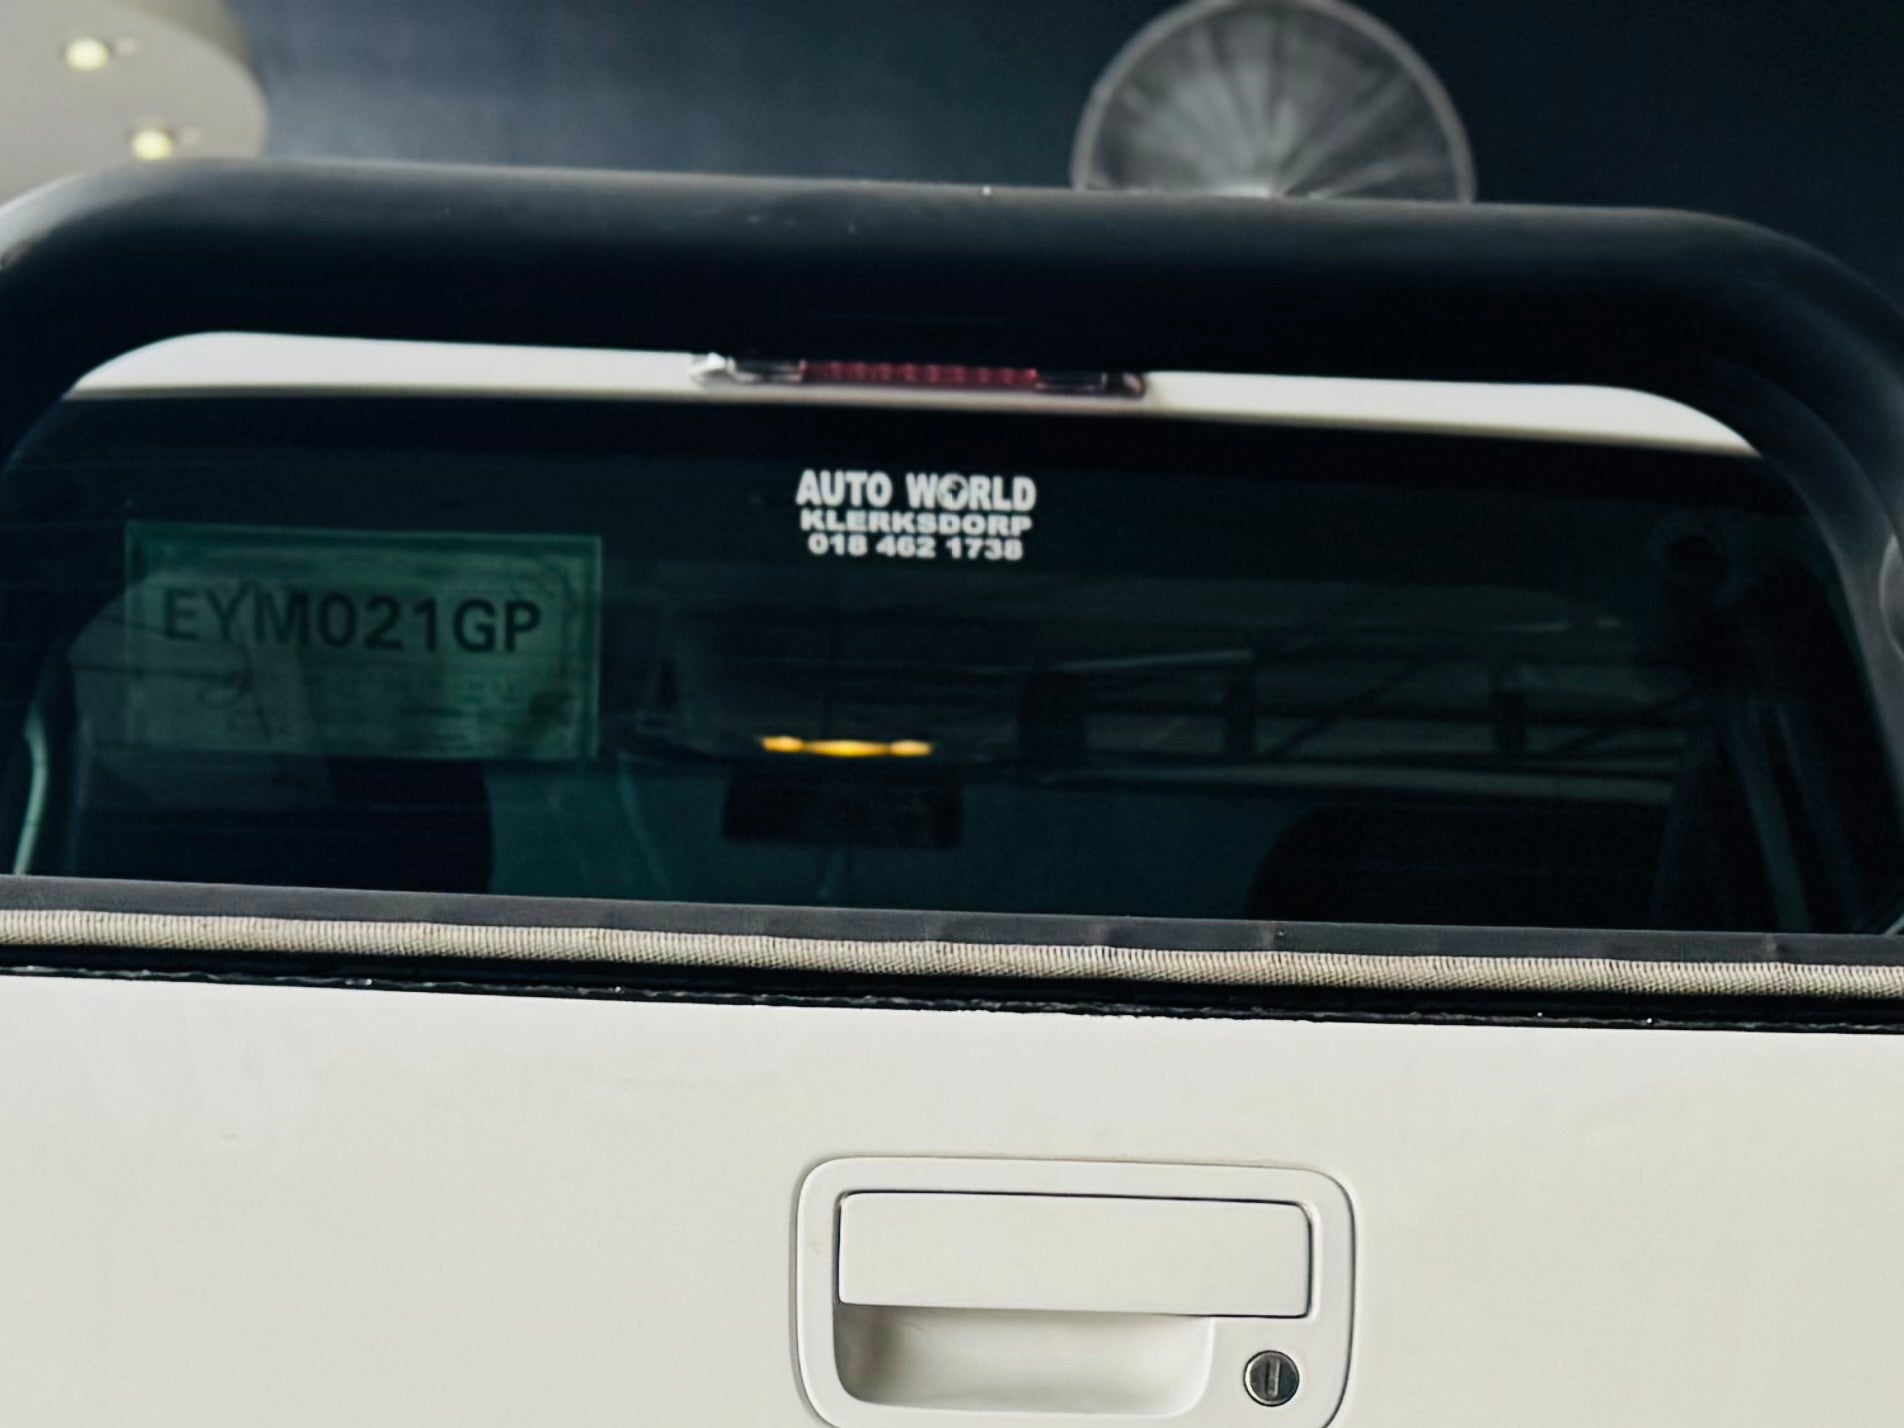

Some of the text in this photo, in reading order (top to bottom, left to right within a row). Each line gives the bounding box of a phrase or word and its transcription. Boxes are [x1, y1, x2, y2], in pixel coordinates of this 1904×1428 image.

[795, 468, 1038, 512] AUTO WORLD
[799, 508, 1033, 537] KLERKSDORP
[807, 532, 1024, 561] 018 462 1738
[162, 586, 543, 654] EYM021GP
